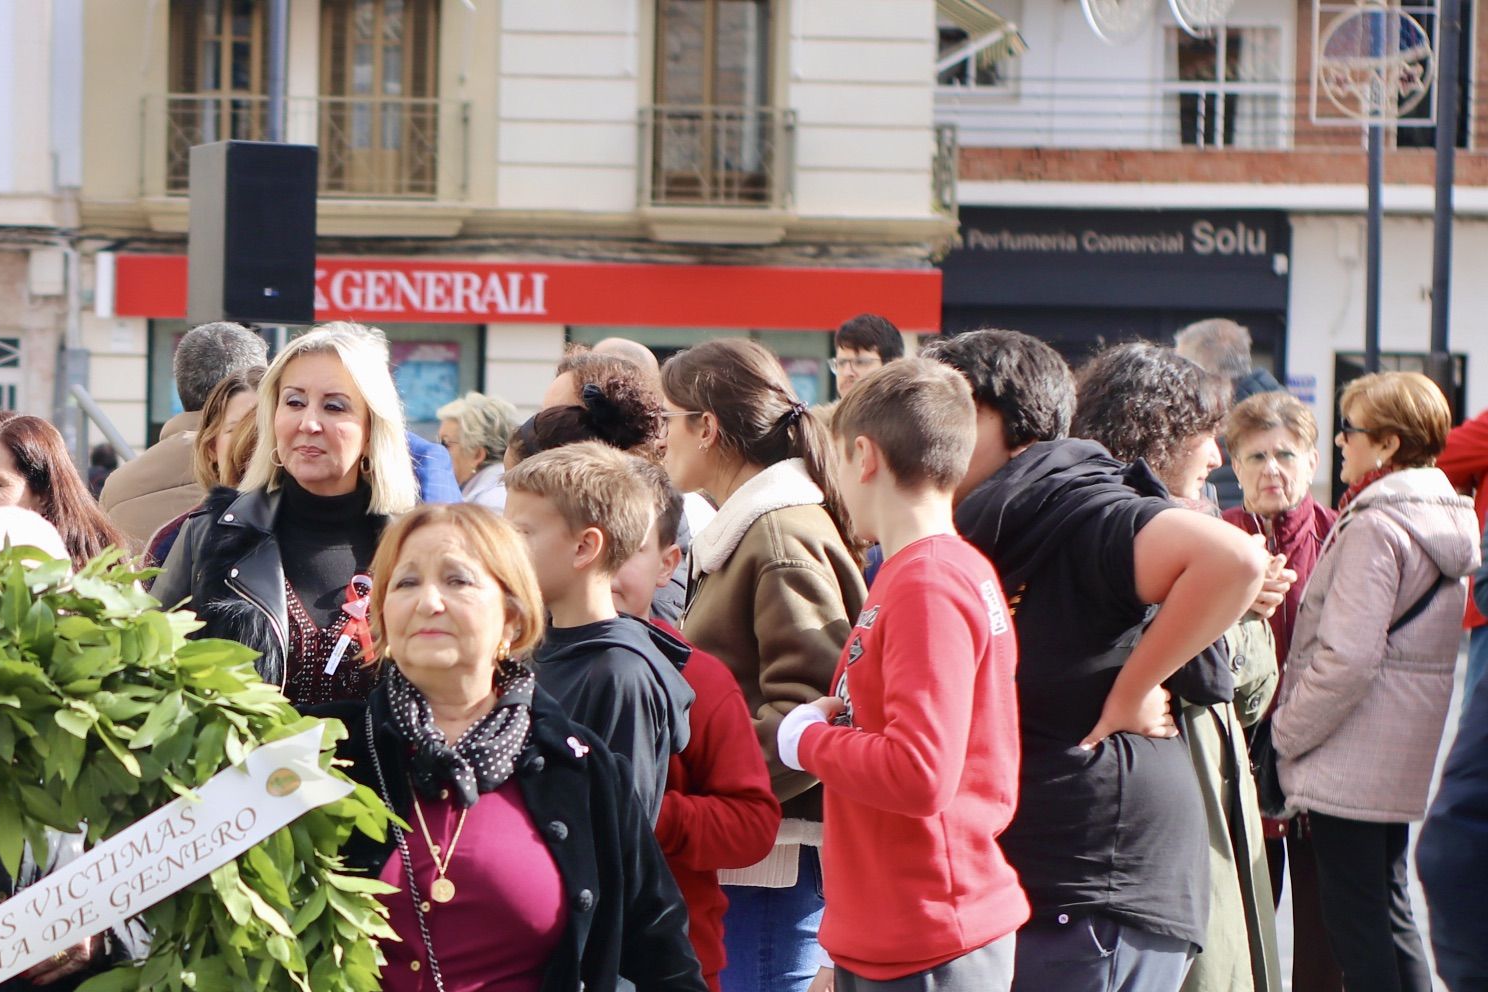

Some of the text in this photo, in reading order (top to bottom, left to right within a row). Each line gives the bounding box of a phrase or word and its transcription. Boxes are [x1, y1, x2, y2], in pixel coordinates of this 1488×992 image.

[1081, 229, 1184, 253] Comercial
[1191, 219, 1267, 255] Solu
[329, 269, 549, 315] GENERALI
[25, 806, 198, 918] VICTIMAS
[41, 903, 100, 944] DE
[109, 806, 258, 915] GENERO
